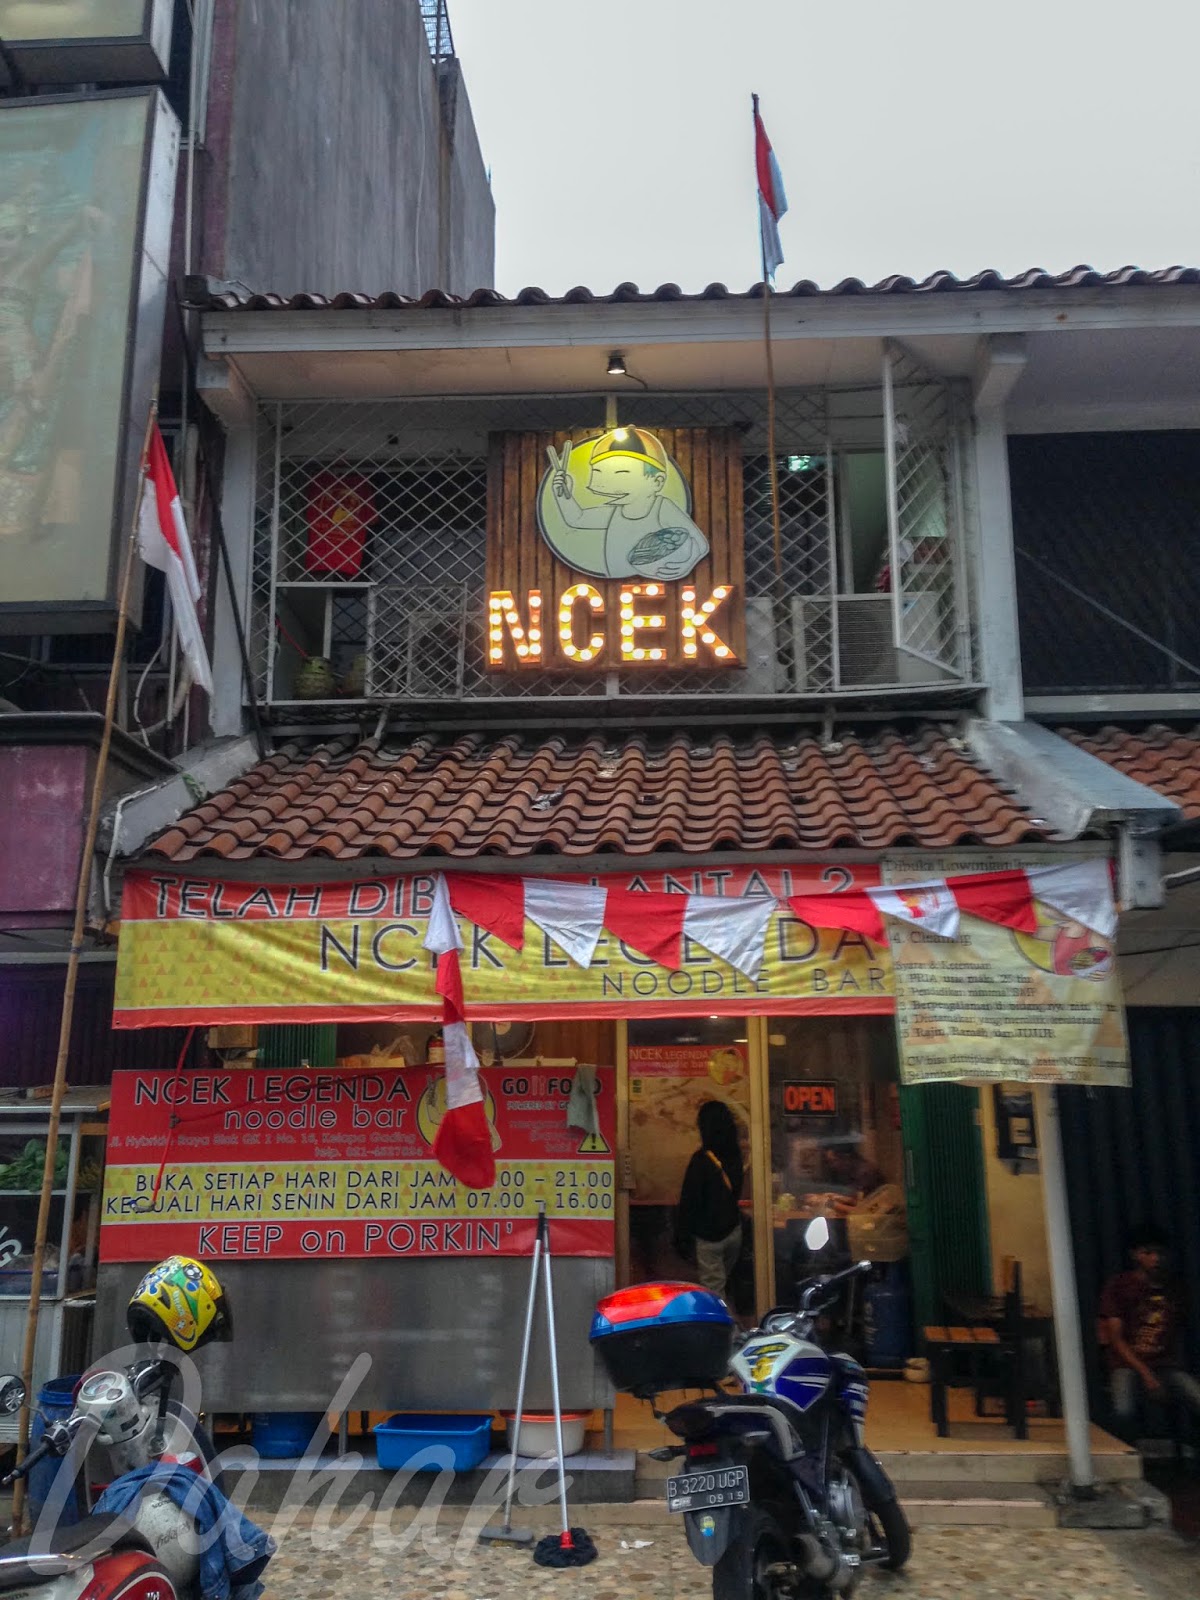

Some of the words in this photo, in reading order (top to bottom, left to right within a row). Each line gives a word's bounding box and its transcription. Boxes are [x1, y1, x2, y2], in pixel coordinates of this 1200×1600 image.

[489, 584, 740, 665] NCEK
[150, 877, 321, 919] TELAH
[822, 866, 854, 893] 2
[320, 923, 505, 972] NCK
[602, 969, 769, 996] NOODLE
[812, 967, 886, 992] BAR
[135, 1077, 231, 1105] NCEK
[247, 1075, 411, 1103] LEGENDA
[502, 1077, 529, 1096] GO
[784, 1086, 835, 1111] OPEN
[224, 1104, 338, 1129] noodle
[352, 1104, 407, 1128] bar
[136, 1174, 193, 1192] BUKA
[204, 1173, 275, 1190] SETIAP
[285, 1172, 336, 1189] HARI
[347, 1171, 398, 1188] DARI
[409, 1171, 457, 1188] JAM
[555, 1171, 612, 1188] 21.00
[106, 1195, 199, 1214] KECUALI
[211, 1194, 261, 1211] HARI
[272, 1193, 334, 1210] SENIN
[346, 1192, 398, 1209] DARI
[409, 1192, 456, 1208] JAM
[467, 1192, 525, 1209] 07.00
[555, 1192, 612, 1209] 16.00
[199, 1225, 283, 1254] KEEP
[301, 1229, 345, 1252] on
[364, 1222, 513, 1251] PORKIN'
[669, 1481, 677, 1497] B
[682, 1474, 715, 1494] 3220
[719, 1470, 744, 1488] UGP
[709, 1494, 724, 1504] 09
